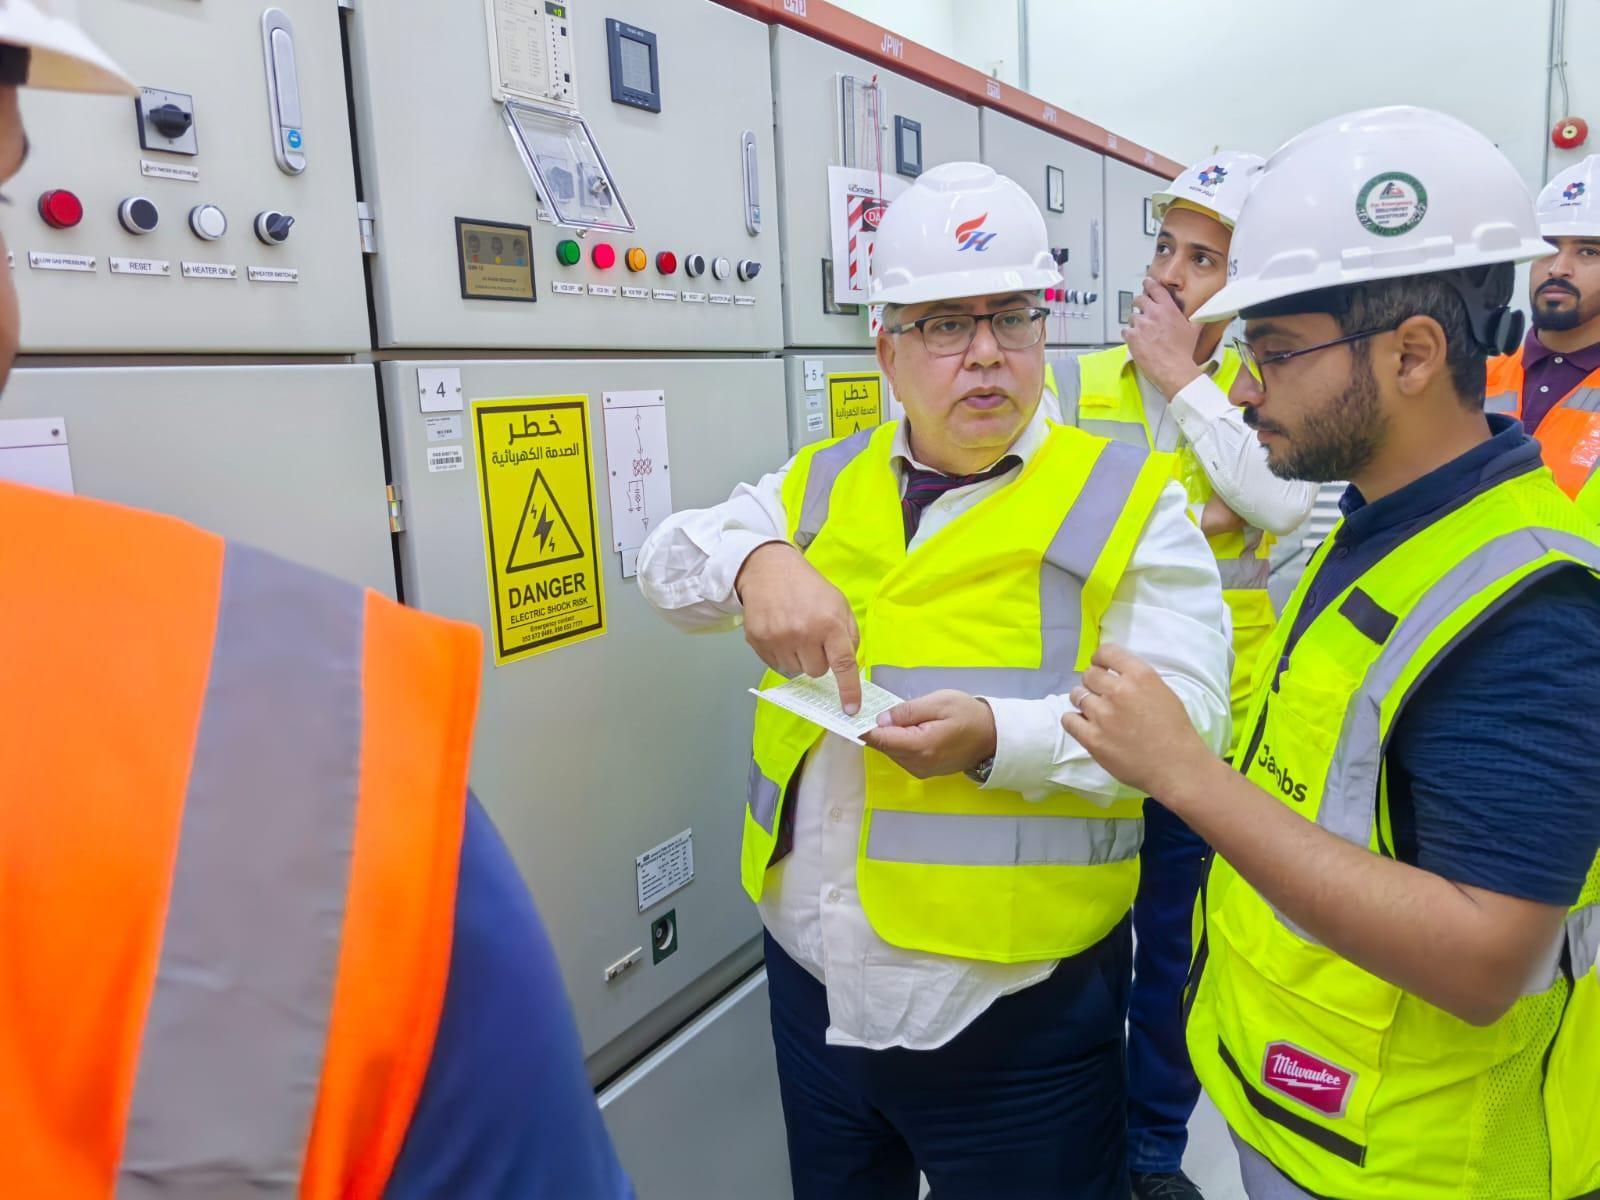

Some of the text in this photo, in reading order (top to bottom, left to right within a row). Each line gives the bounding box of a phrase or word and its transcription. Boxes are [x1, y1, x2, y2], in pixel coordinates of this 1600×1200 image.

[129, 262, 152, 271] RESET
[812, 369, 817, 381] 5
[436, 381, 446, 398] 4
[843, 384, 868, 405] خطر
[508, 414, 561, 446] خطر
[492, 442, 579, 467] الصدمة الكهربائية
[508, 572, 586, 609] DANGER
[510, 597, 588, 625] ELECTRIC SHOCK RISK
[530, 621, 557, 632] Emergency
[1271, 1053, 1341, 1085] Milwaukee
